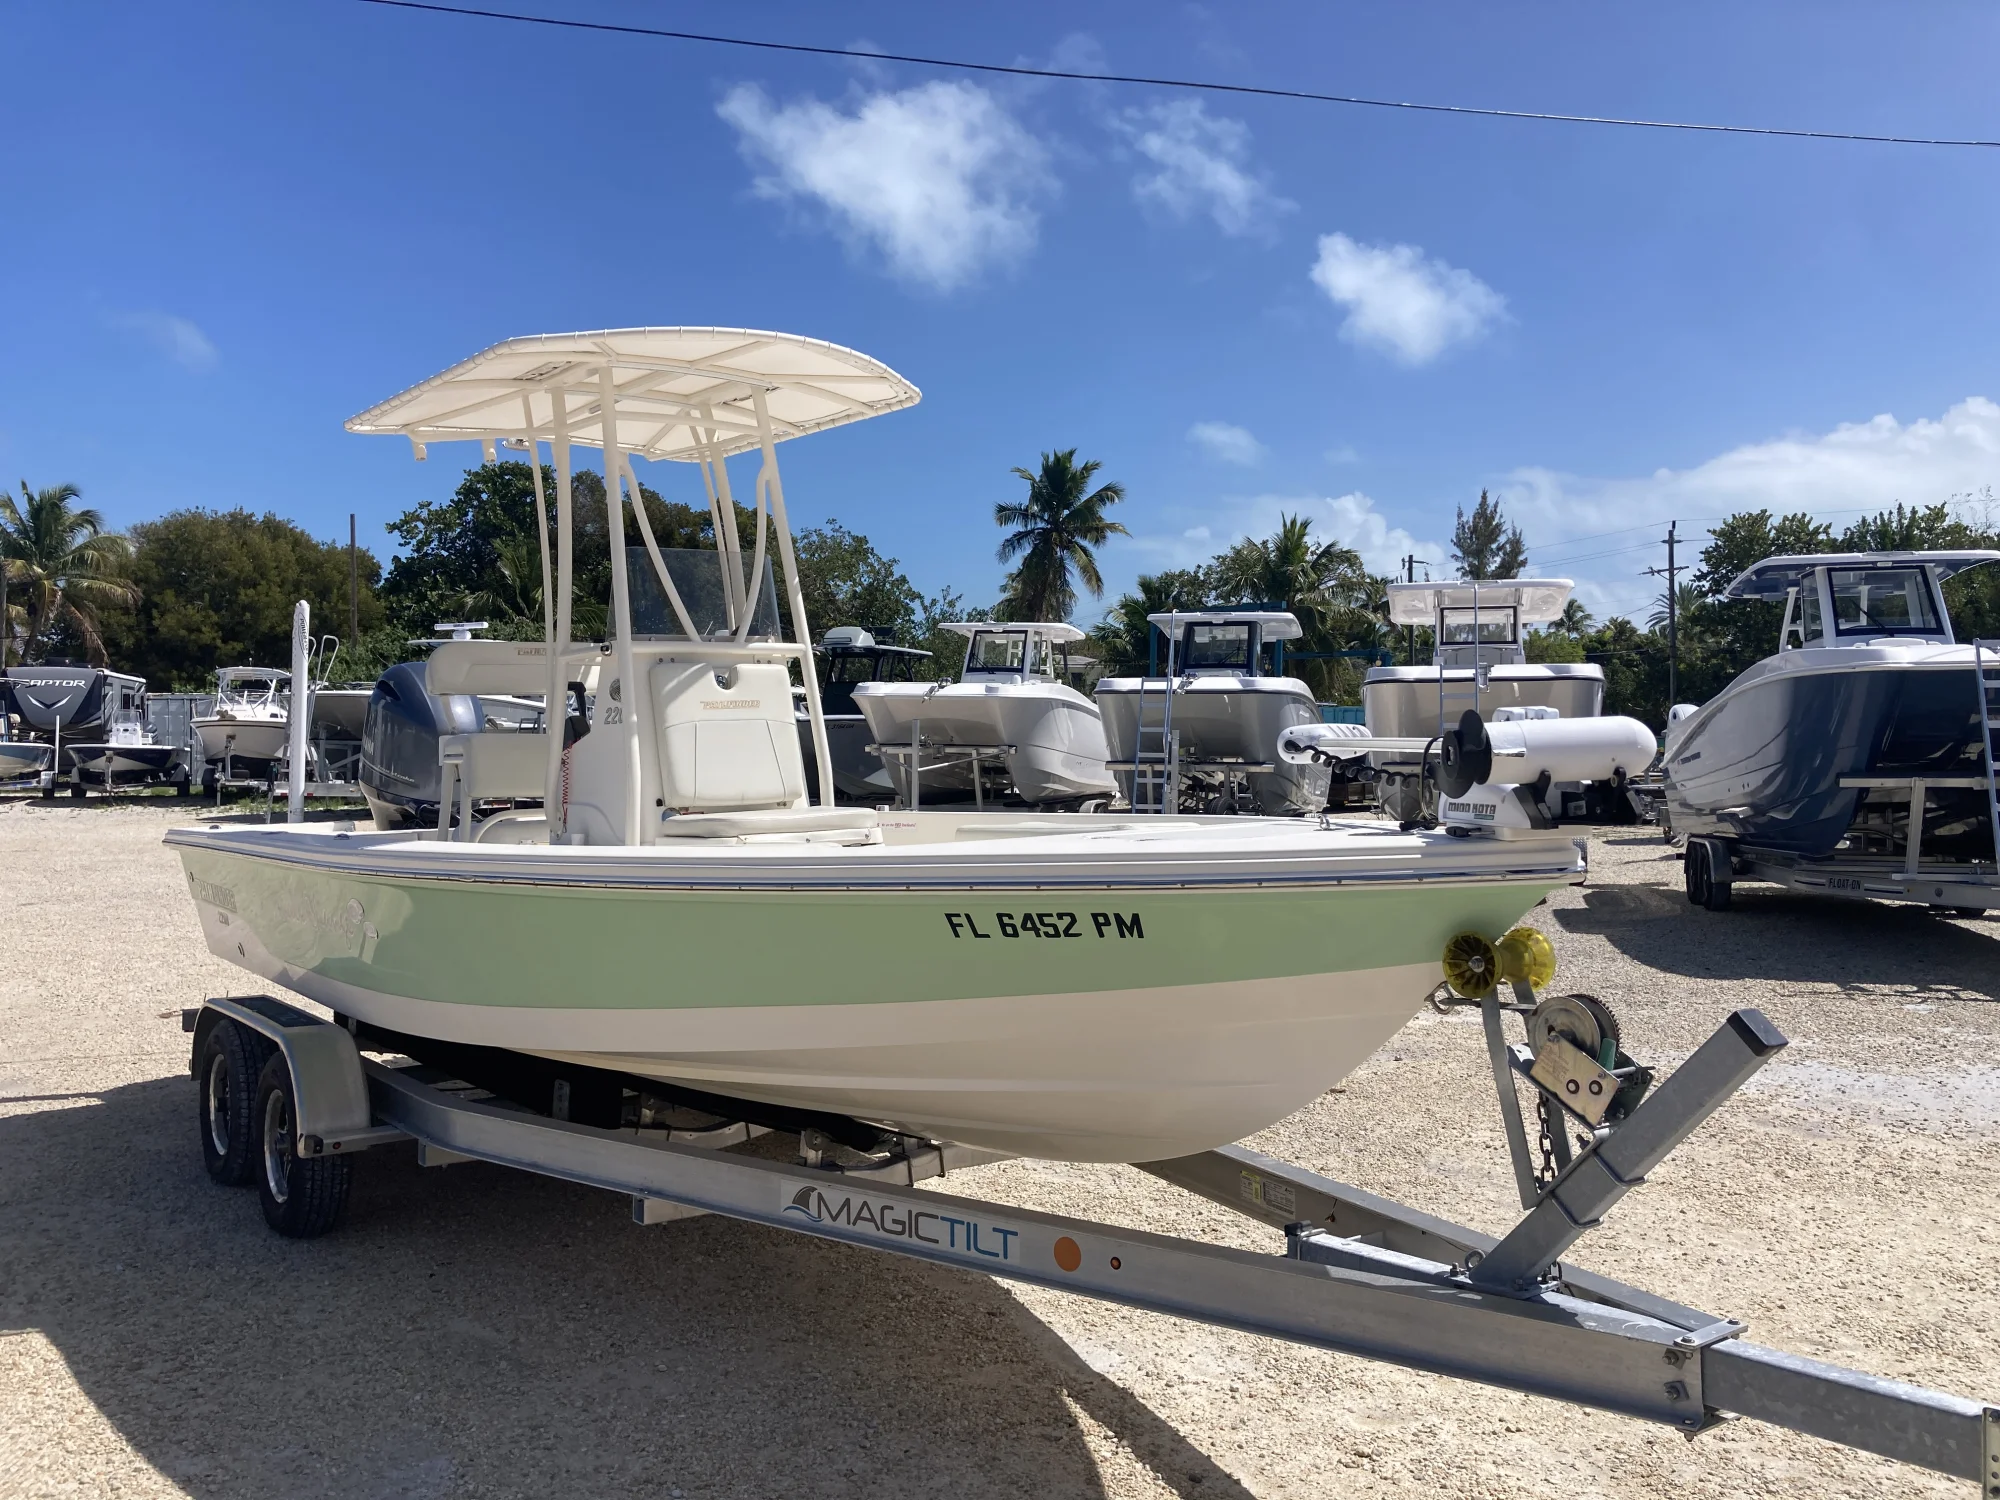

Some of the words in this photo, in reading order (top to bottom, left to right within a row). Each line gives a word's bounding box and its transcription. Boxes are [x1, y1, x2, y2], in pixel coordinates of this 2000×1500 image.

[1448, 802, 1471, 813] MINN
[1472, 803, 1497, 815] KOTA
[1828, 877, 1861, 890] FLOAT-ON
[944, 912, 991, 938] FL
[996, 912, 1083, 938] 6452
[1090, 912, 1145, 939] PM
[816, 1191, 1019, 1260] MAGICTILT
